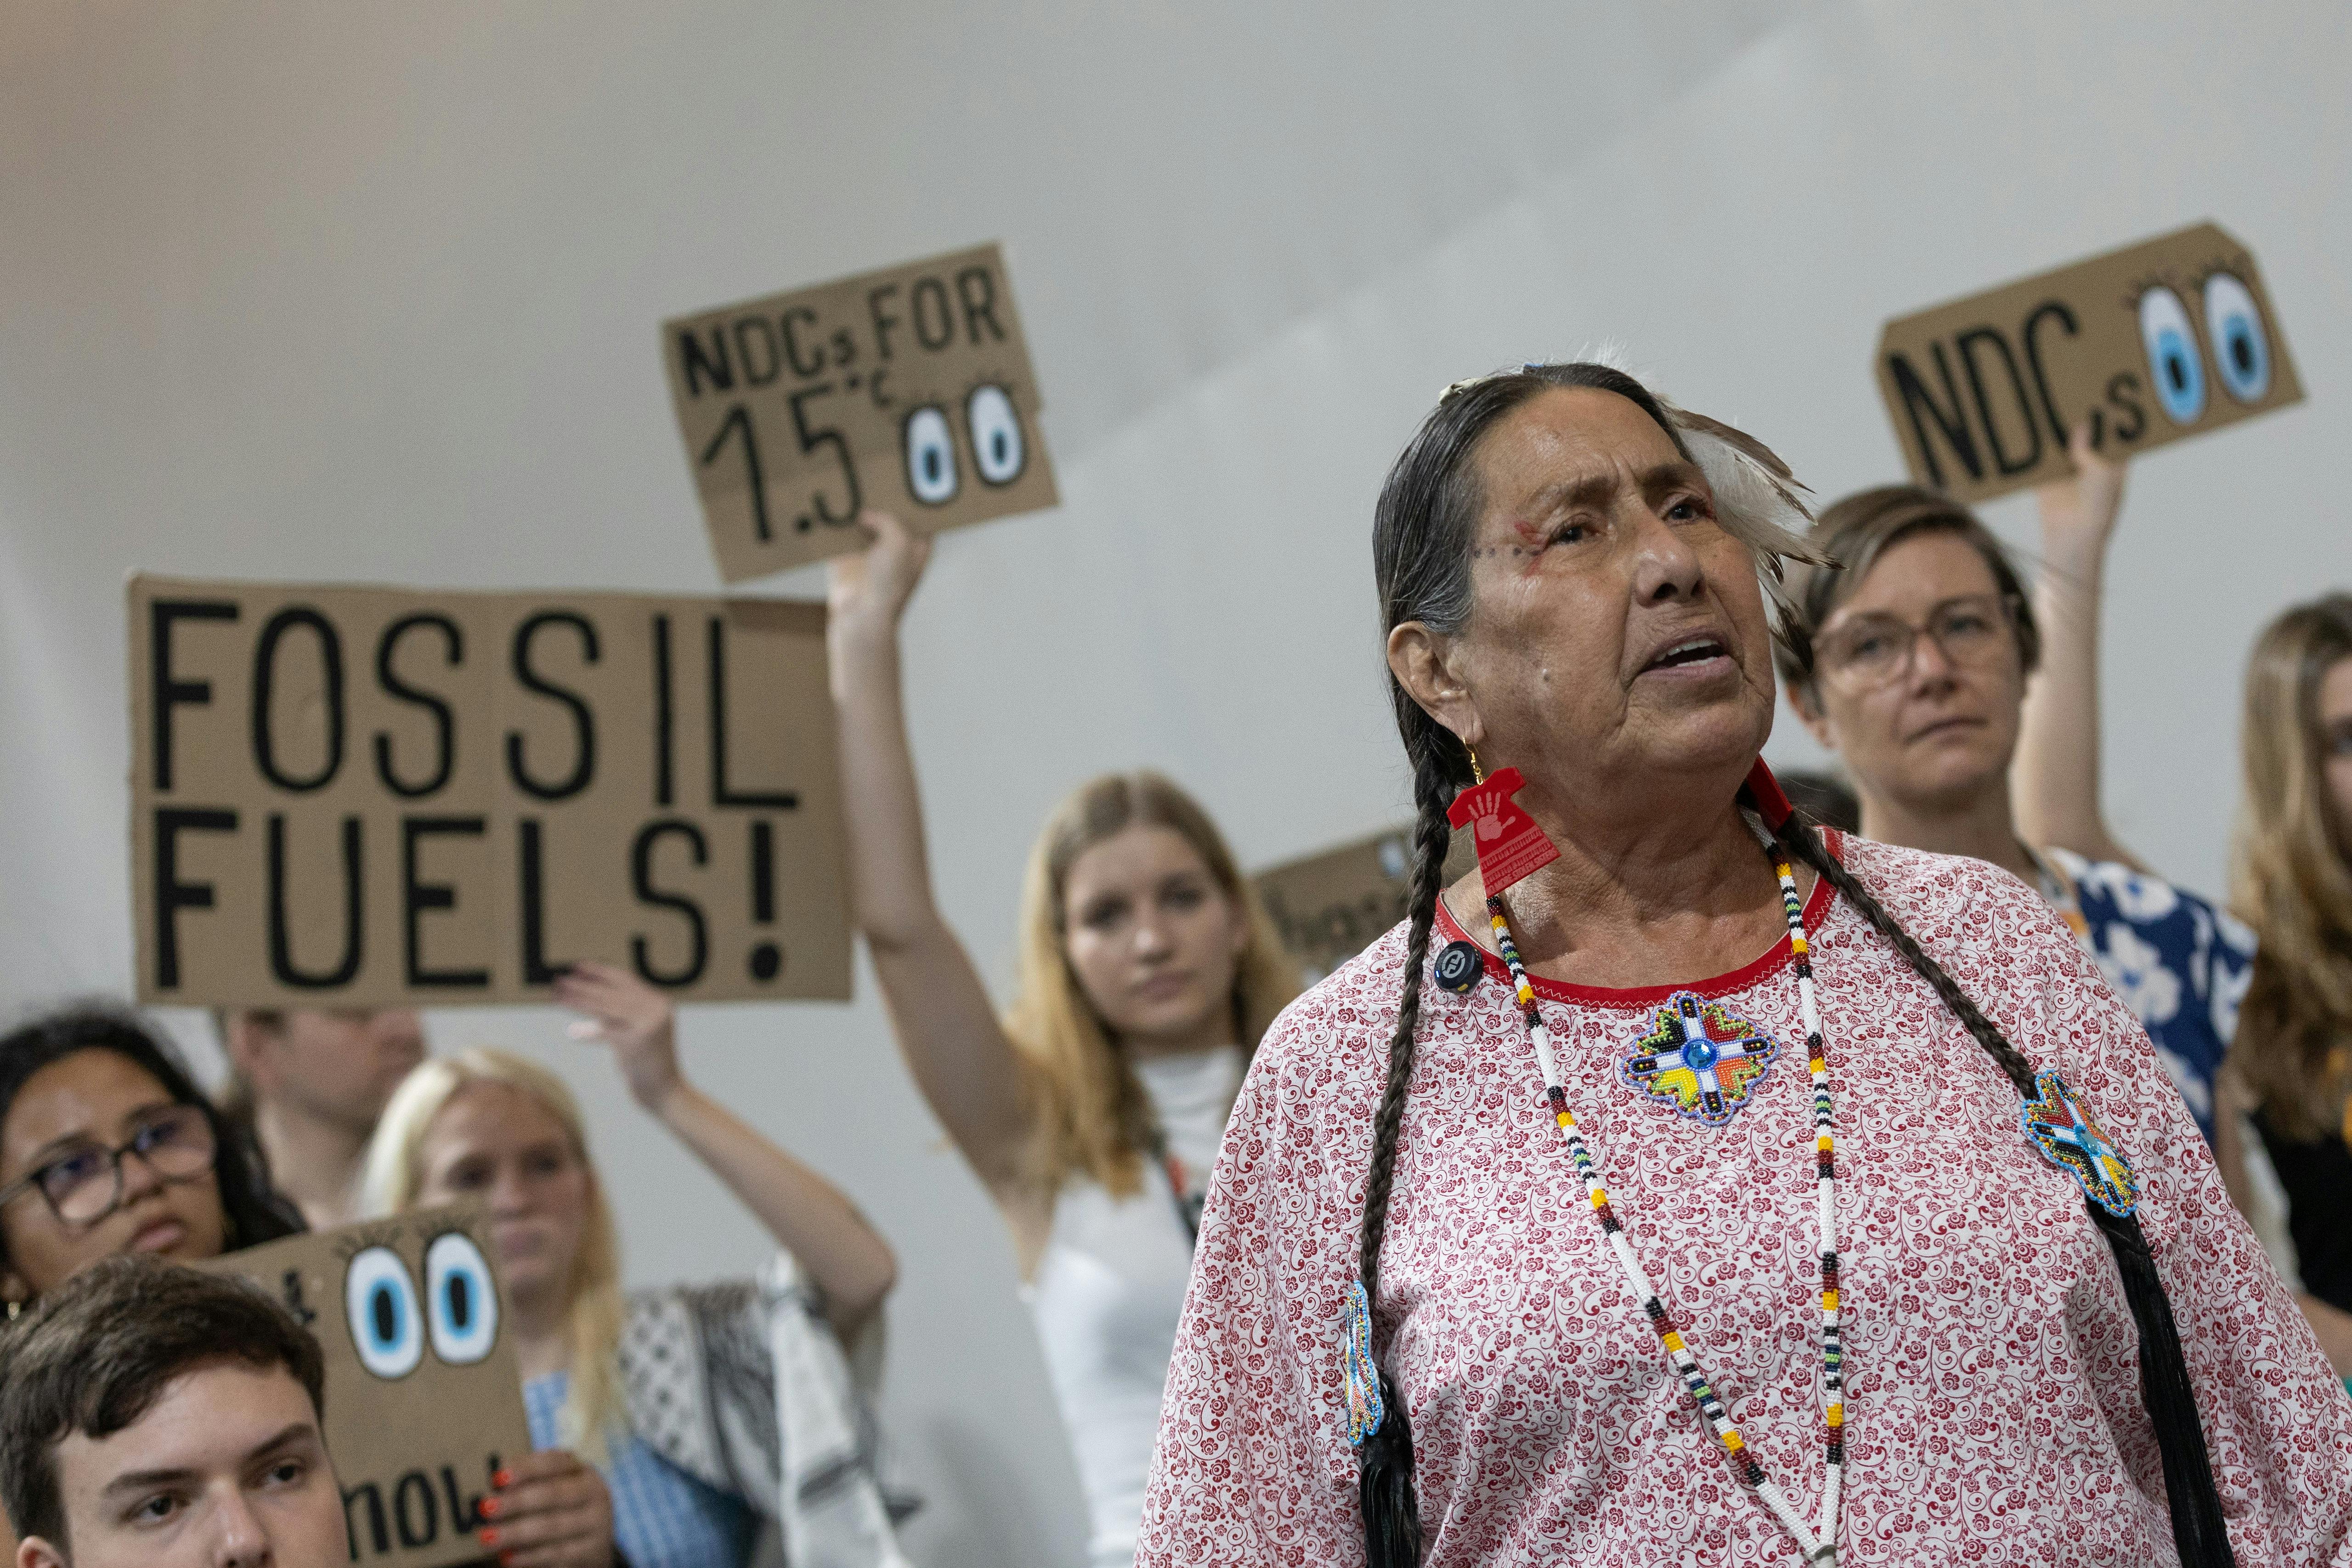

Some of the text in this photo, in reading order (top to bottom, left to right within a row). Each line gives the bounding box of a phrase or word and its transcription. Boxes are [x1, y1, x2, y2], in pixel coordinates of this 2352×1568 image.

[678, 265, 1007, 397] NDCs FOR
[1889, 298, 2148, 488] NDCs
[150, 599, 801, 809] FOSSIL
[153, 806, 783, 991] FUELS!
